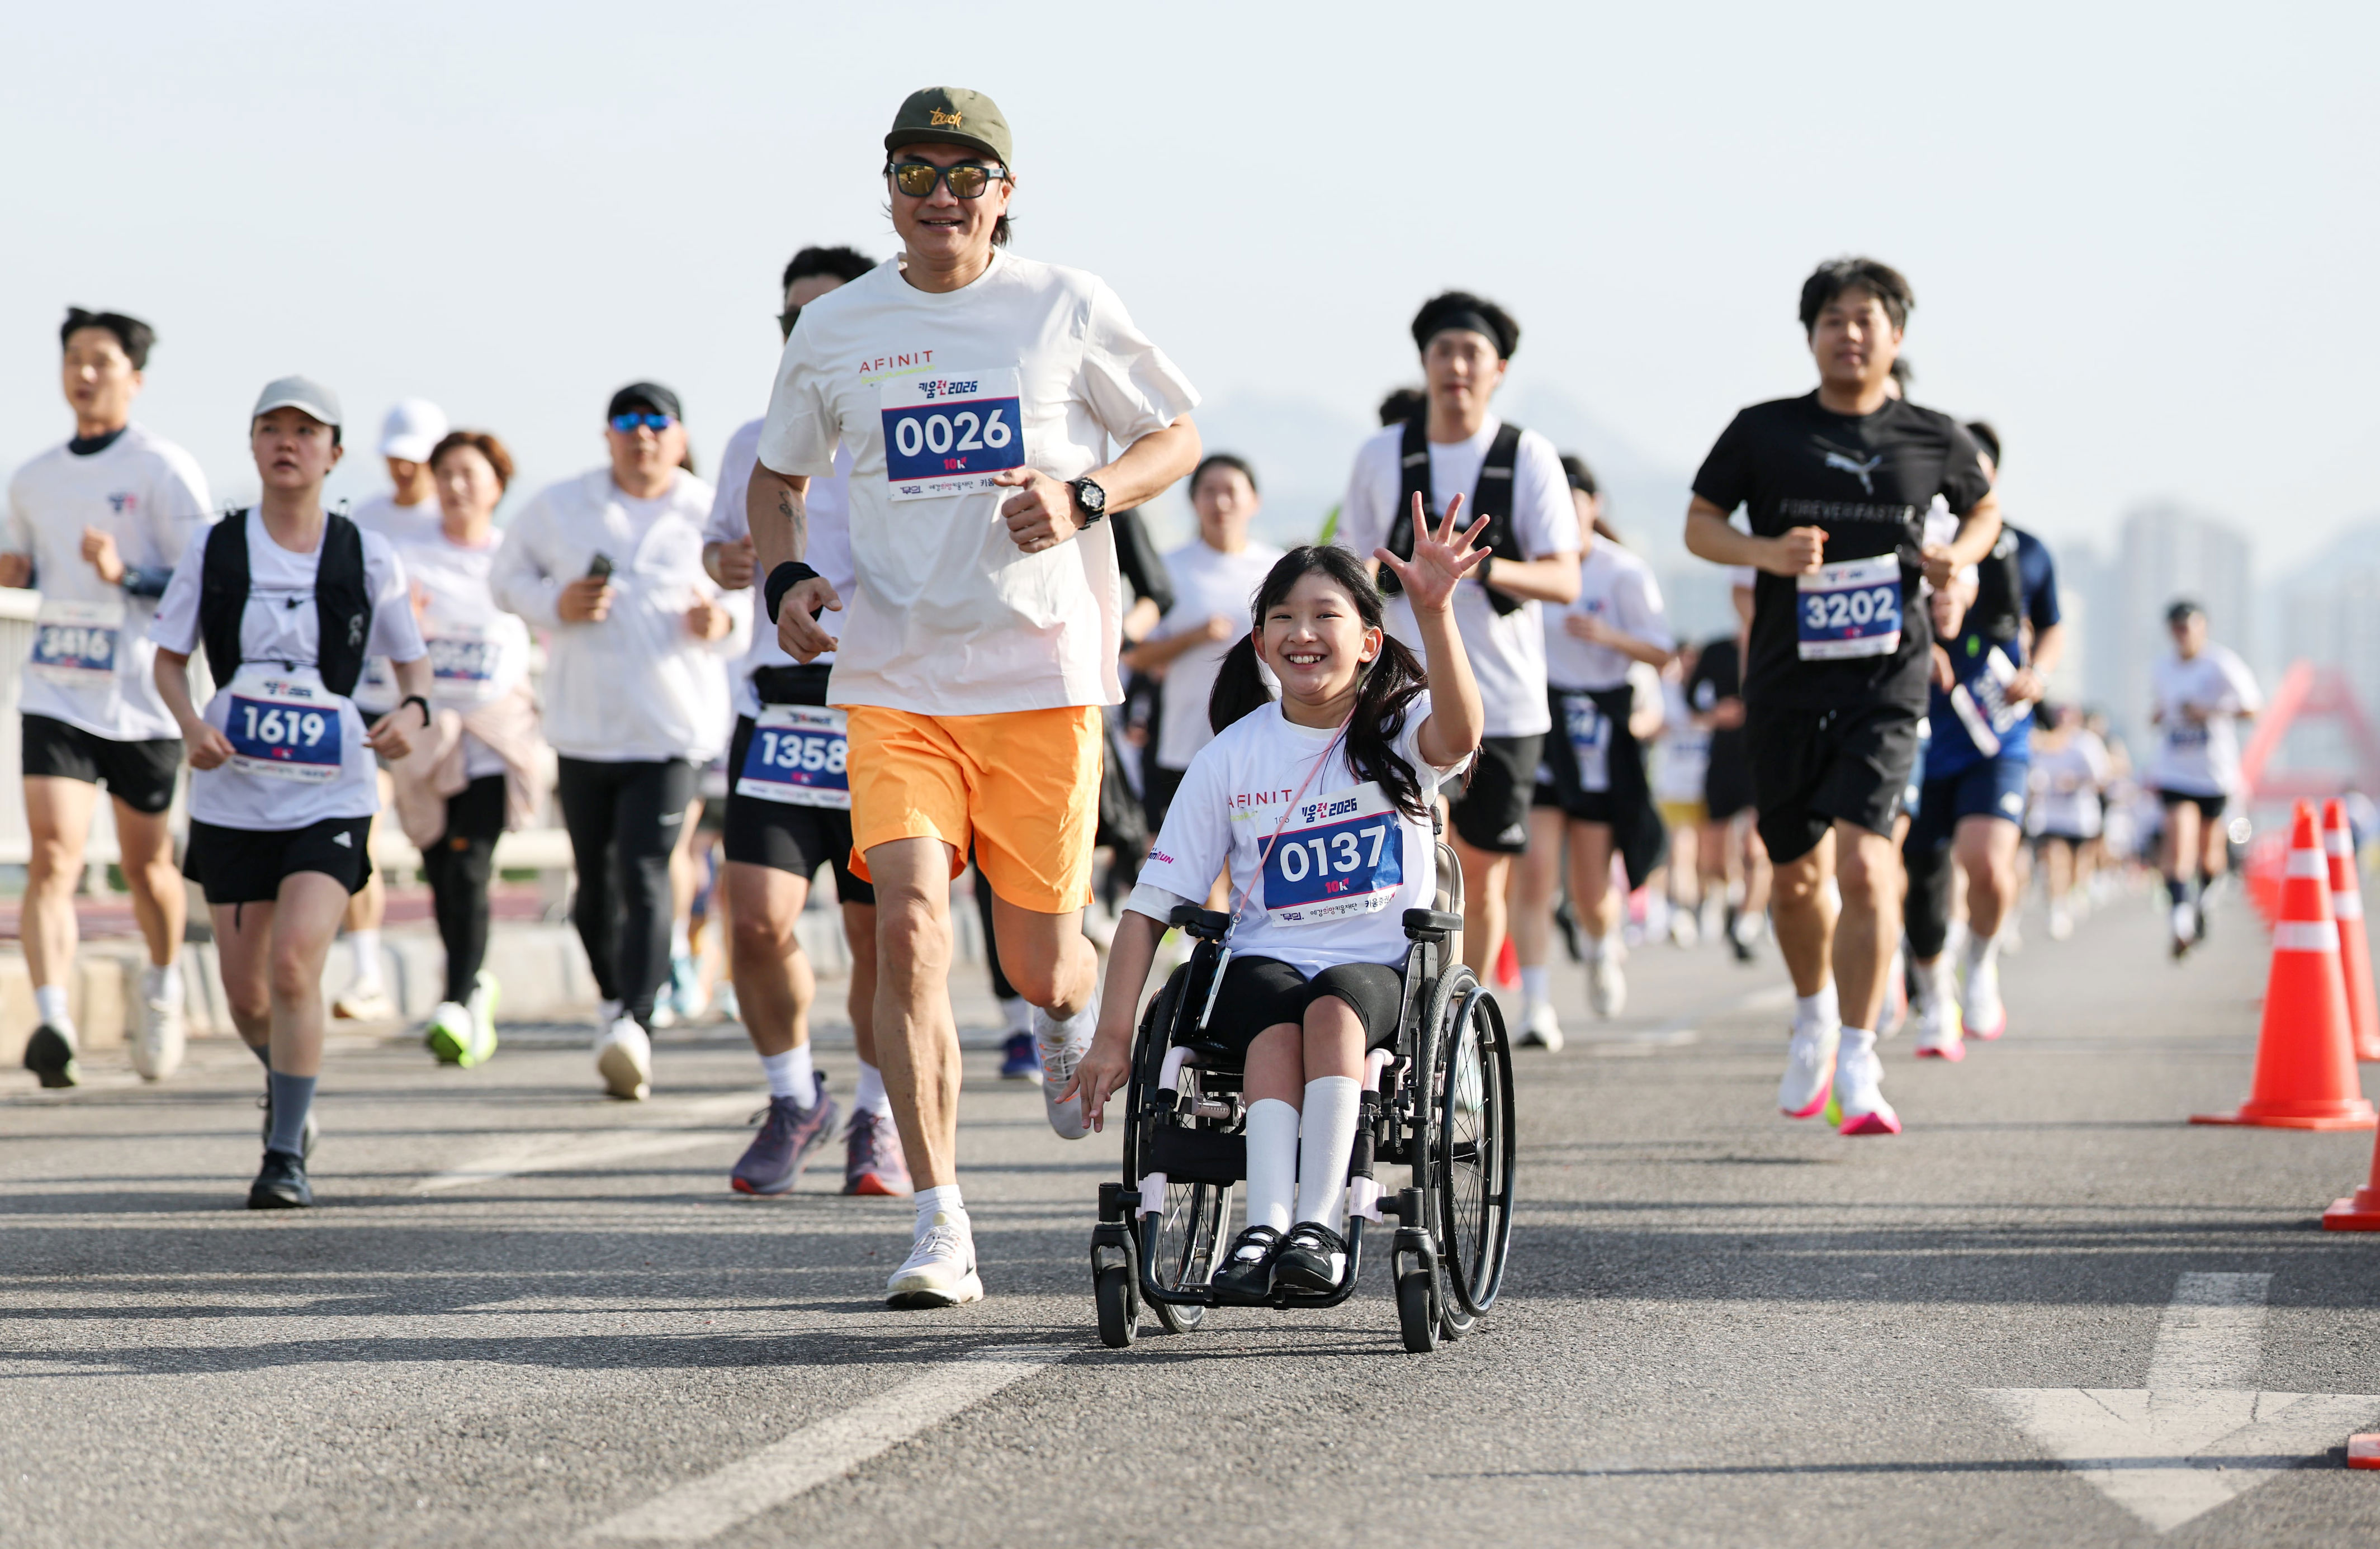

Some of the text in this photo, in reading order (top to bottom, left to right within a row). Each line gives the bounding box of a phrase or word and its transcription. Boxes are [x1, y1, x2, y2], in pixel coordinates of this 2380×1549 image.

[859, 350, 933, 373] AFINIT
[948, 381, 978, 395] 2026
[895, 409, 1012, 457] 0026
[944, 456, 967, 470] 10K
[1806, 586, 1898, 630] 3202
[243, 705, 325, 747] 1619
[761, 731, 849, 775] 1358
[1328, 798, 1357, 817] 2026
[1280, 825, 1386, 882] 0137
[1325, 878, 1350, 893] 10K
